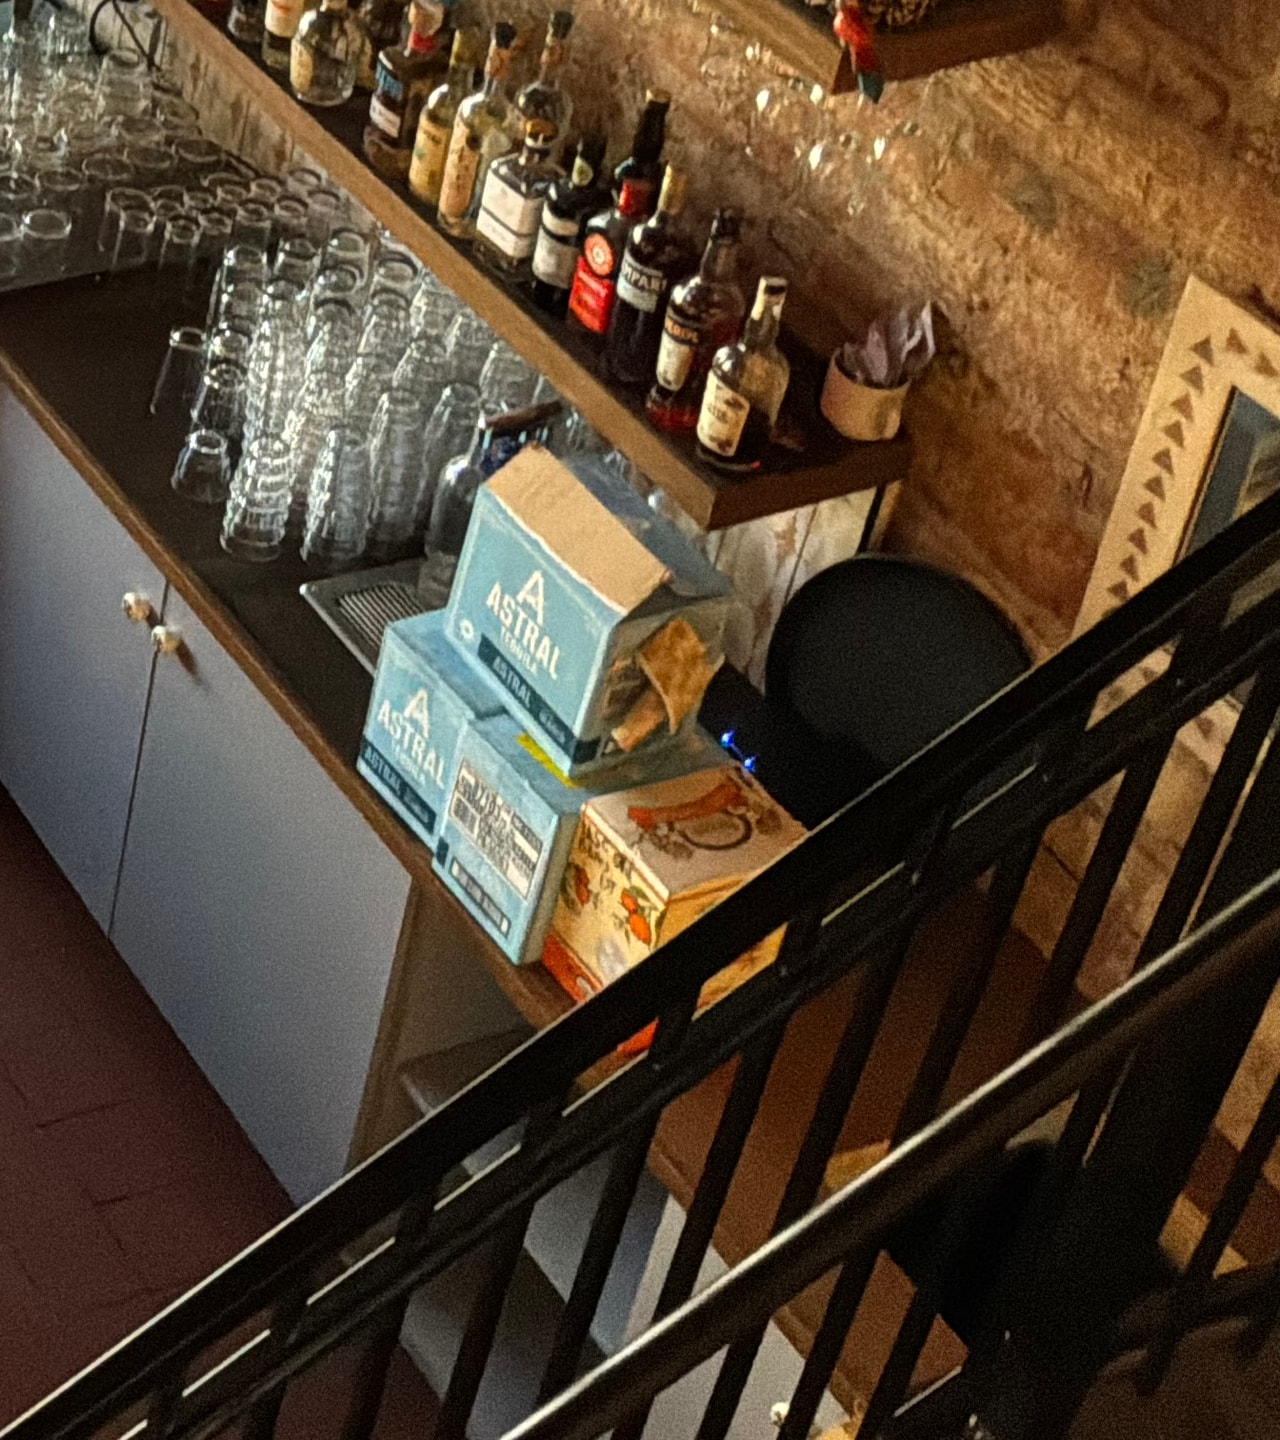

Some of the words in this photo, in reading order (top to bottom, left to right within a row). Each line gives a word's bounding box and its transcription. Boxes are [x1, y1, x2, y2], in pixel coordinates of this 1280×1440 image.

[485, 581, 560, 681] ASTRAL
[492, 655, 532, 710] ASTRAL
[377, 699, 445, 790] ASTRAL
